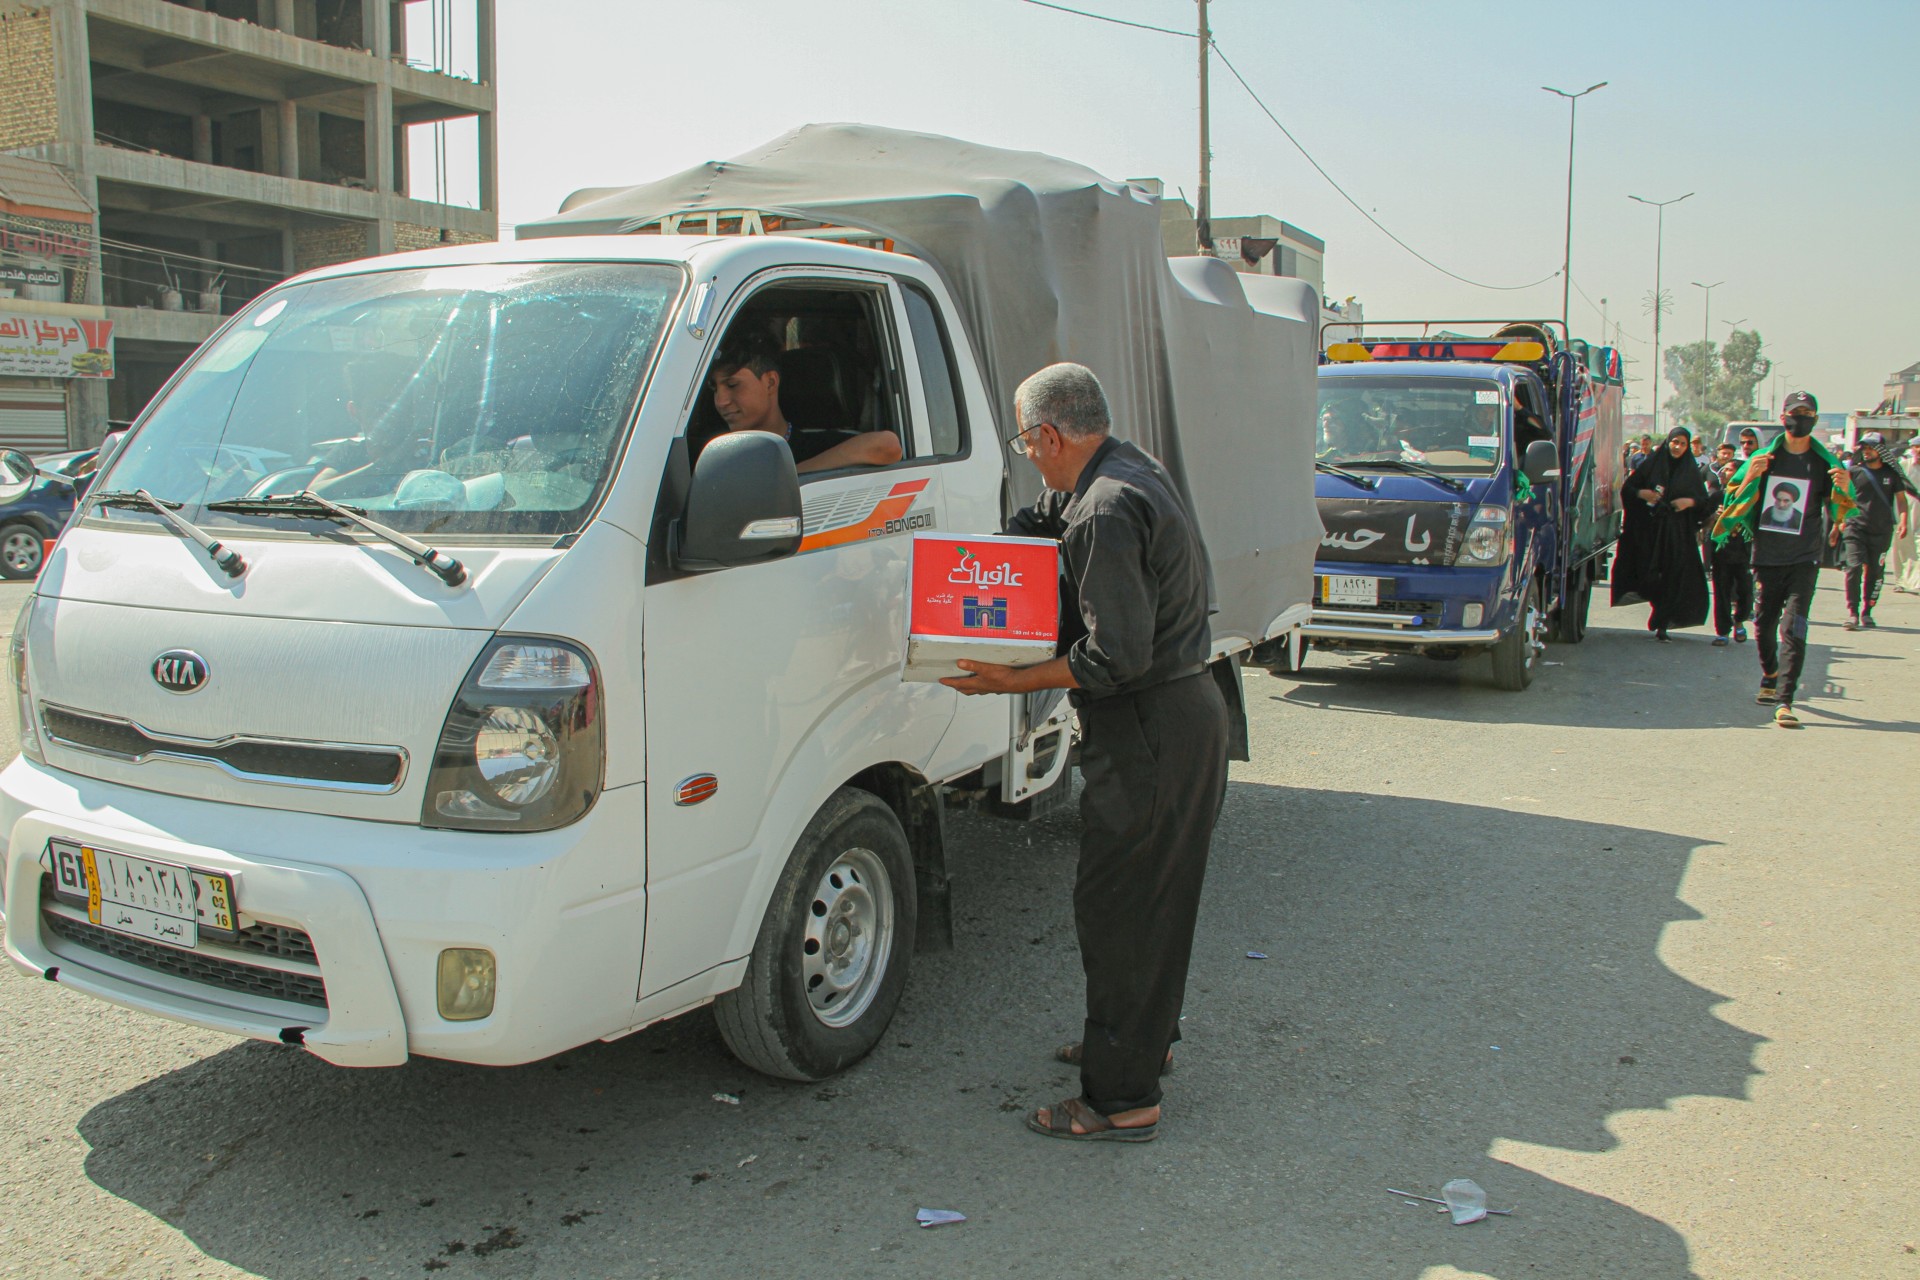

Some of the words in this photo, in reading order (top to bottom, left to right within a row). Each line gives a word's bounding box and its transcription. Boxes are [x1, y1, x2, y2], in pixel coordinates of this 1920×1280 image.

[0, 269, 26, 281] هندس
[27, 272, 59, 284] تصاميم
[0, 317, 29, 339] الم
[33, 319, 80, 347] مركز
[1408, 344, 1455, 358] KIA
[885, 515, 924, 534] BONGO
[1320, 528, 1386, 550] حس
[1405, 513, 1431, 565] يا
[948, 550, 1023, 590] عافيات
[157, 658, 197, 685] KIA
[87, 853, 98, 906] IRAQ
[209, 878, 223, 892] 12
[212, 895, 226, 910] 02
[117, 910, 133, 925] حمل
[214, 912, 229, 927] 16
[154, 917, 184, 940] البصرة
